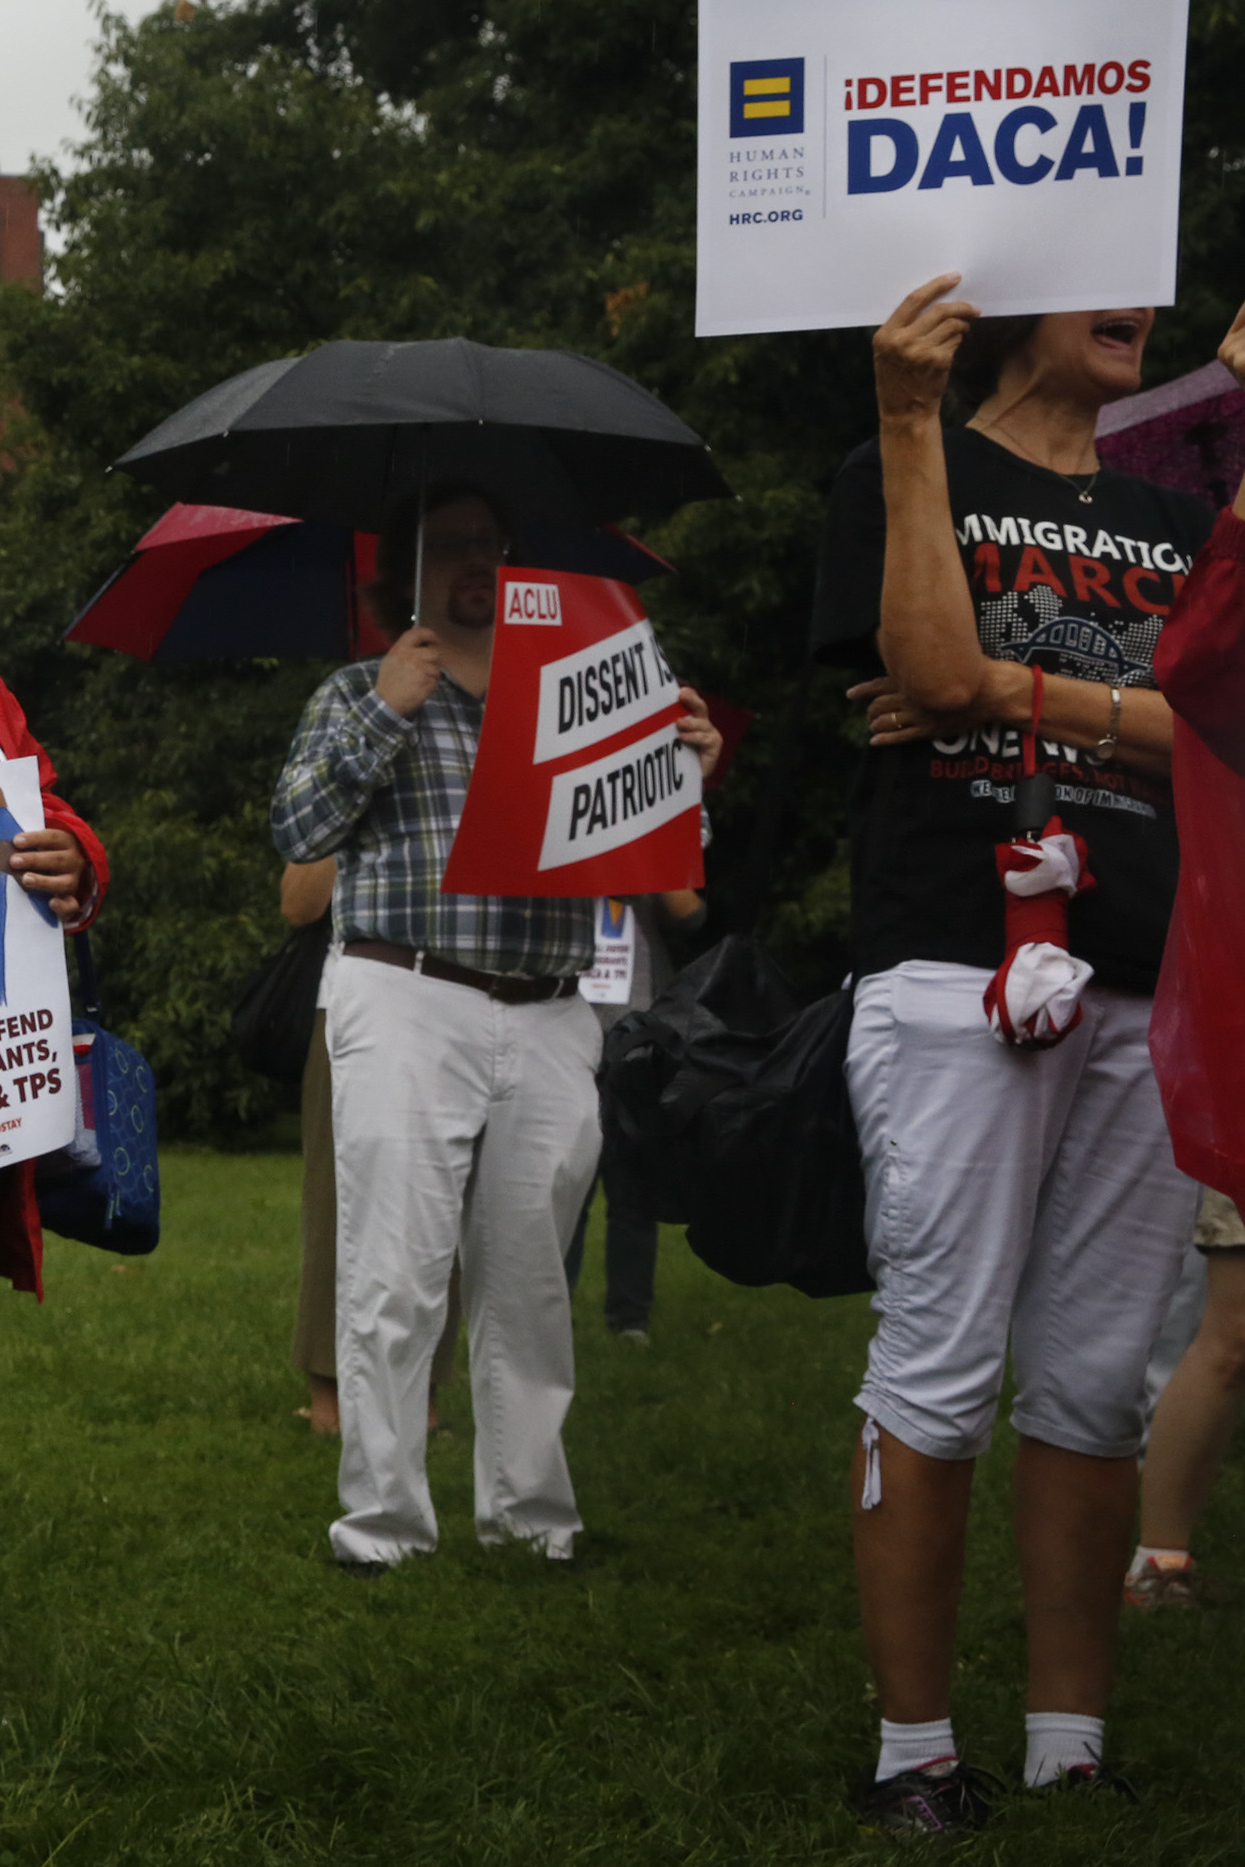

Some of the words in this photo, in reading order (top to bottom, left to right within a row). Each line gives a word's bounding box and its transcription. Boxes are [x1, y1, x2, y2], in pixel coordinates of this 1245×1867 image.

[844, 59, 1152, 111] ¡DEFENDAMOS
[729, 147, 805, 162] HUMAN
[847, 102, 1147, 195] DACA!
[729, 167, 805, 183] RIGHTS
[728, 209, 804, 225] HRC.ORG
[956, 513, 1193, 576] MMIGRATIO
[509, 587, 558, 620] ACLU
[972, 542, 1188, 616] MARC
[558, 642, 648, 735] DISSENT
[568, 739, 683, 841] PATRIOTIC
[13, 1068, 62, 1103] TPS
